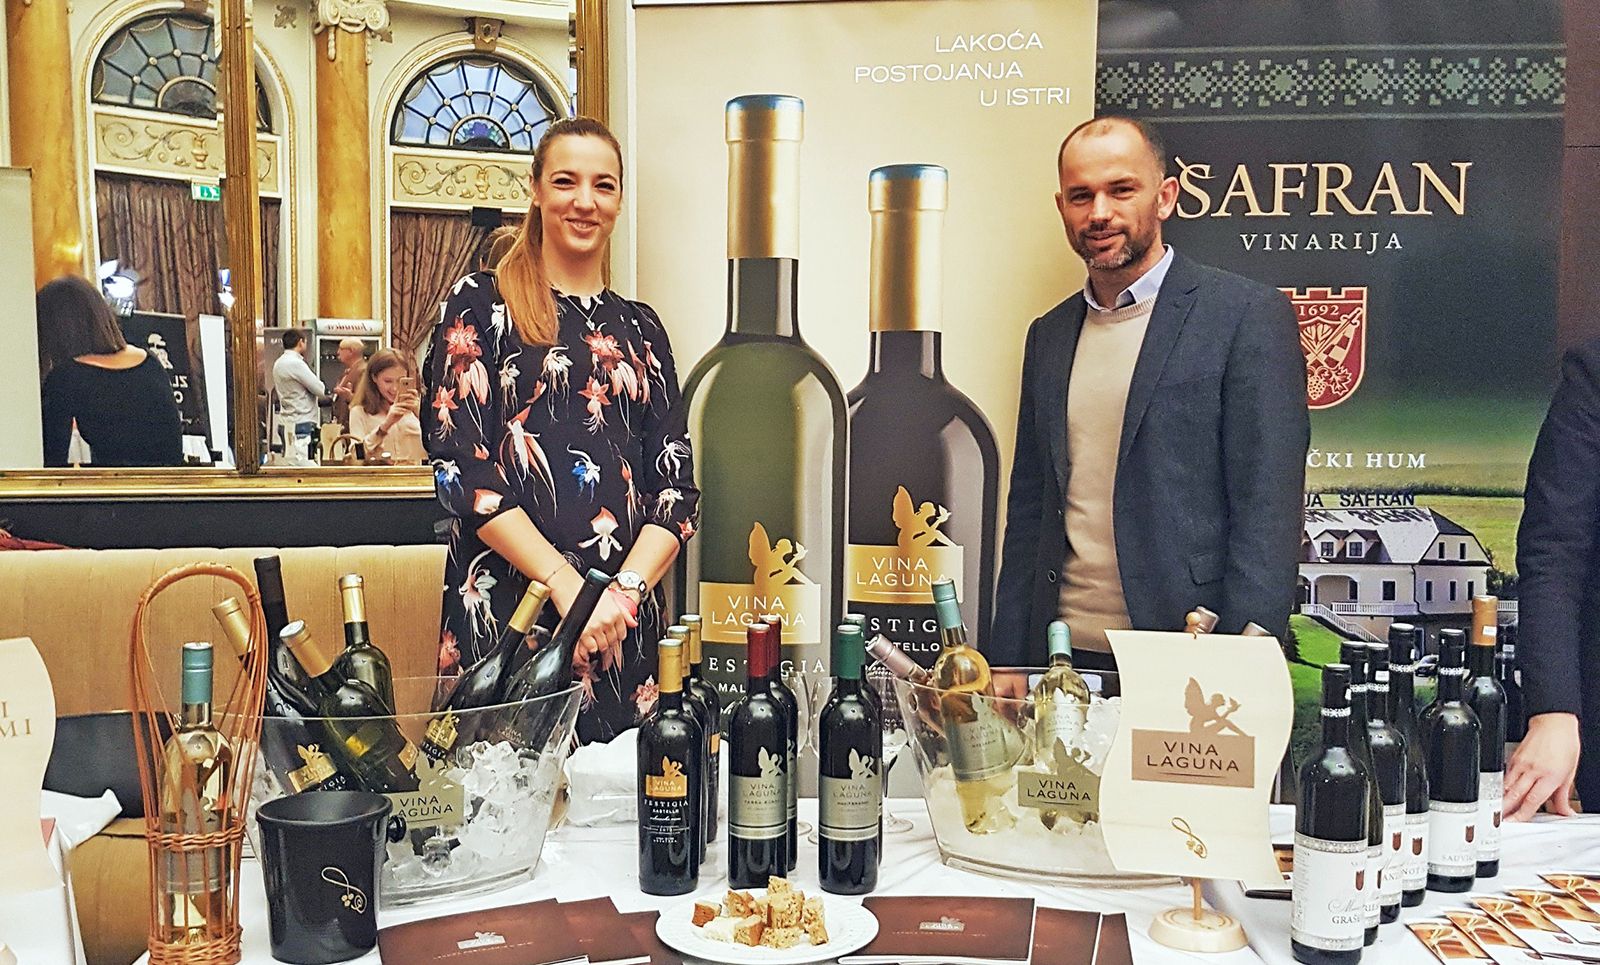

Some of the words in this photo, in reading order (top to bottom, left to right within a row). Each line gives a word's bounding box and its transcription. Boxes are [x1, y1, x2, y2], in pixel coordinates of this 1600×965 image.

[935, 29, 1044, 53] LAKOĆA
[855, 61, 1024, 83] POSTOJANJA
[980, 89, 998, 106] U
[1007, 87, 1070, 106] ISTRI
[1240, 232, 1403, 255] VINARIJA
[1298, 304, 1339, 316] 1692
[1366, 453, 1426, 469] HUM
[872, 556, 928, 571] VINA
[728, 595, 785, 610] VINA
[711, 610, 806, 626] LAGNA
[708, 656, 825, 674] ESGIA
[1164, 741, 1219, 756] VINA
[1147, 755, 1239, 772] LAGUNA
[1039, 779, 1076, 791] VINA
[399, 795, 439, 807] VINA
[1027, 790, 1091, 801] LAGUNA
